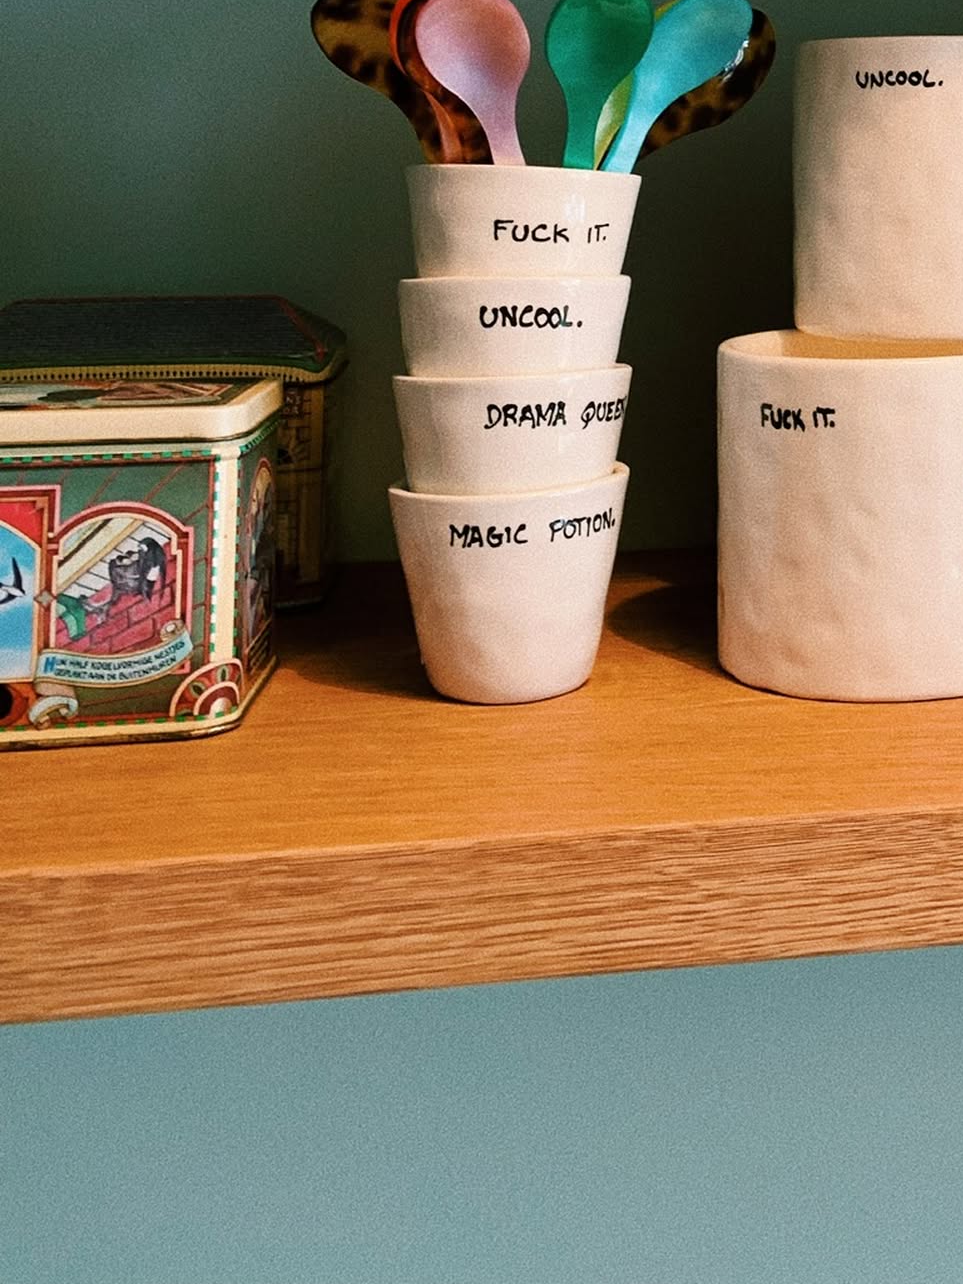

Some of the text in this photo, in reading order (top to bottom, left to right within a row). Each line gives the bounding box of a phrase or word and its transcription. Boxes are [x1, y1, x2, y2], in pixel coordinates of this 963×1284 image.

[854, 68, 944, 90] UNCOOL.
[493, 219, 610, 244] FUCK IT.
[479, 304, 583, 329] UNCOOL.
[483, 400, 567, 430] DRAMA
[760, 402, 836, 433] FUCK IT.
[448, 507, 616, 549] MAGIC POTION.
